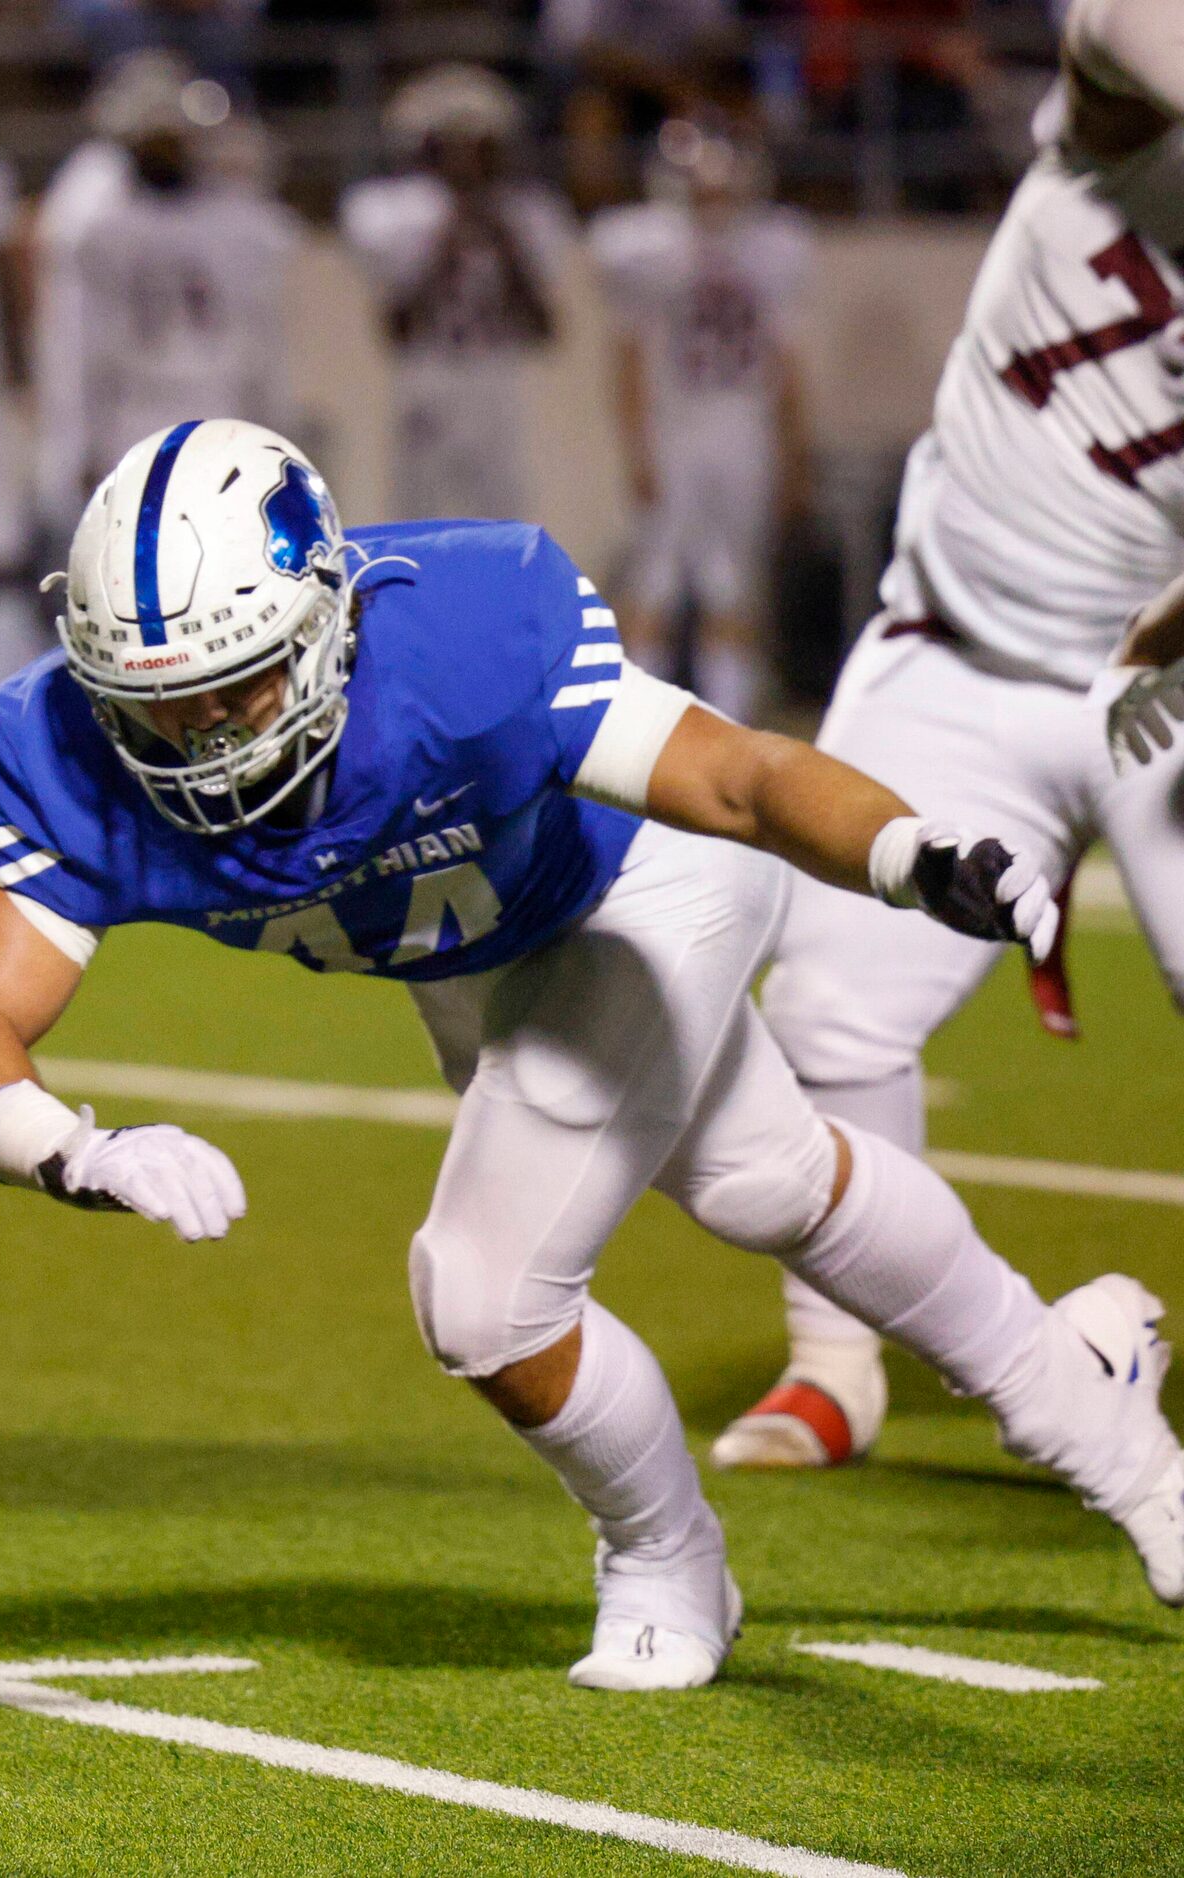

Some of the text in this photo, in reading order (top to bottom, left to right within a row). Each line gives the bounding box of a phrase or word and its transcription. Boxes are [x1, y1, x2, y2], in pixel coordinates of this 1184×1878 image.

[210, 606, 233, 623] WIN
[179, 620, 202, 635] WIN
[232, 624, 255, 642] WIN
[204, 636, 228, 654] WIN
[256, 862, 503, 972] 44
